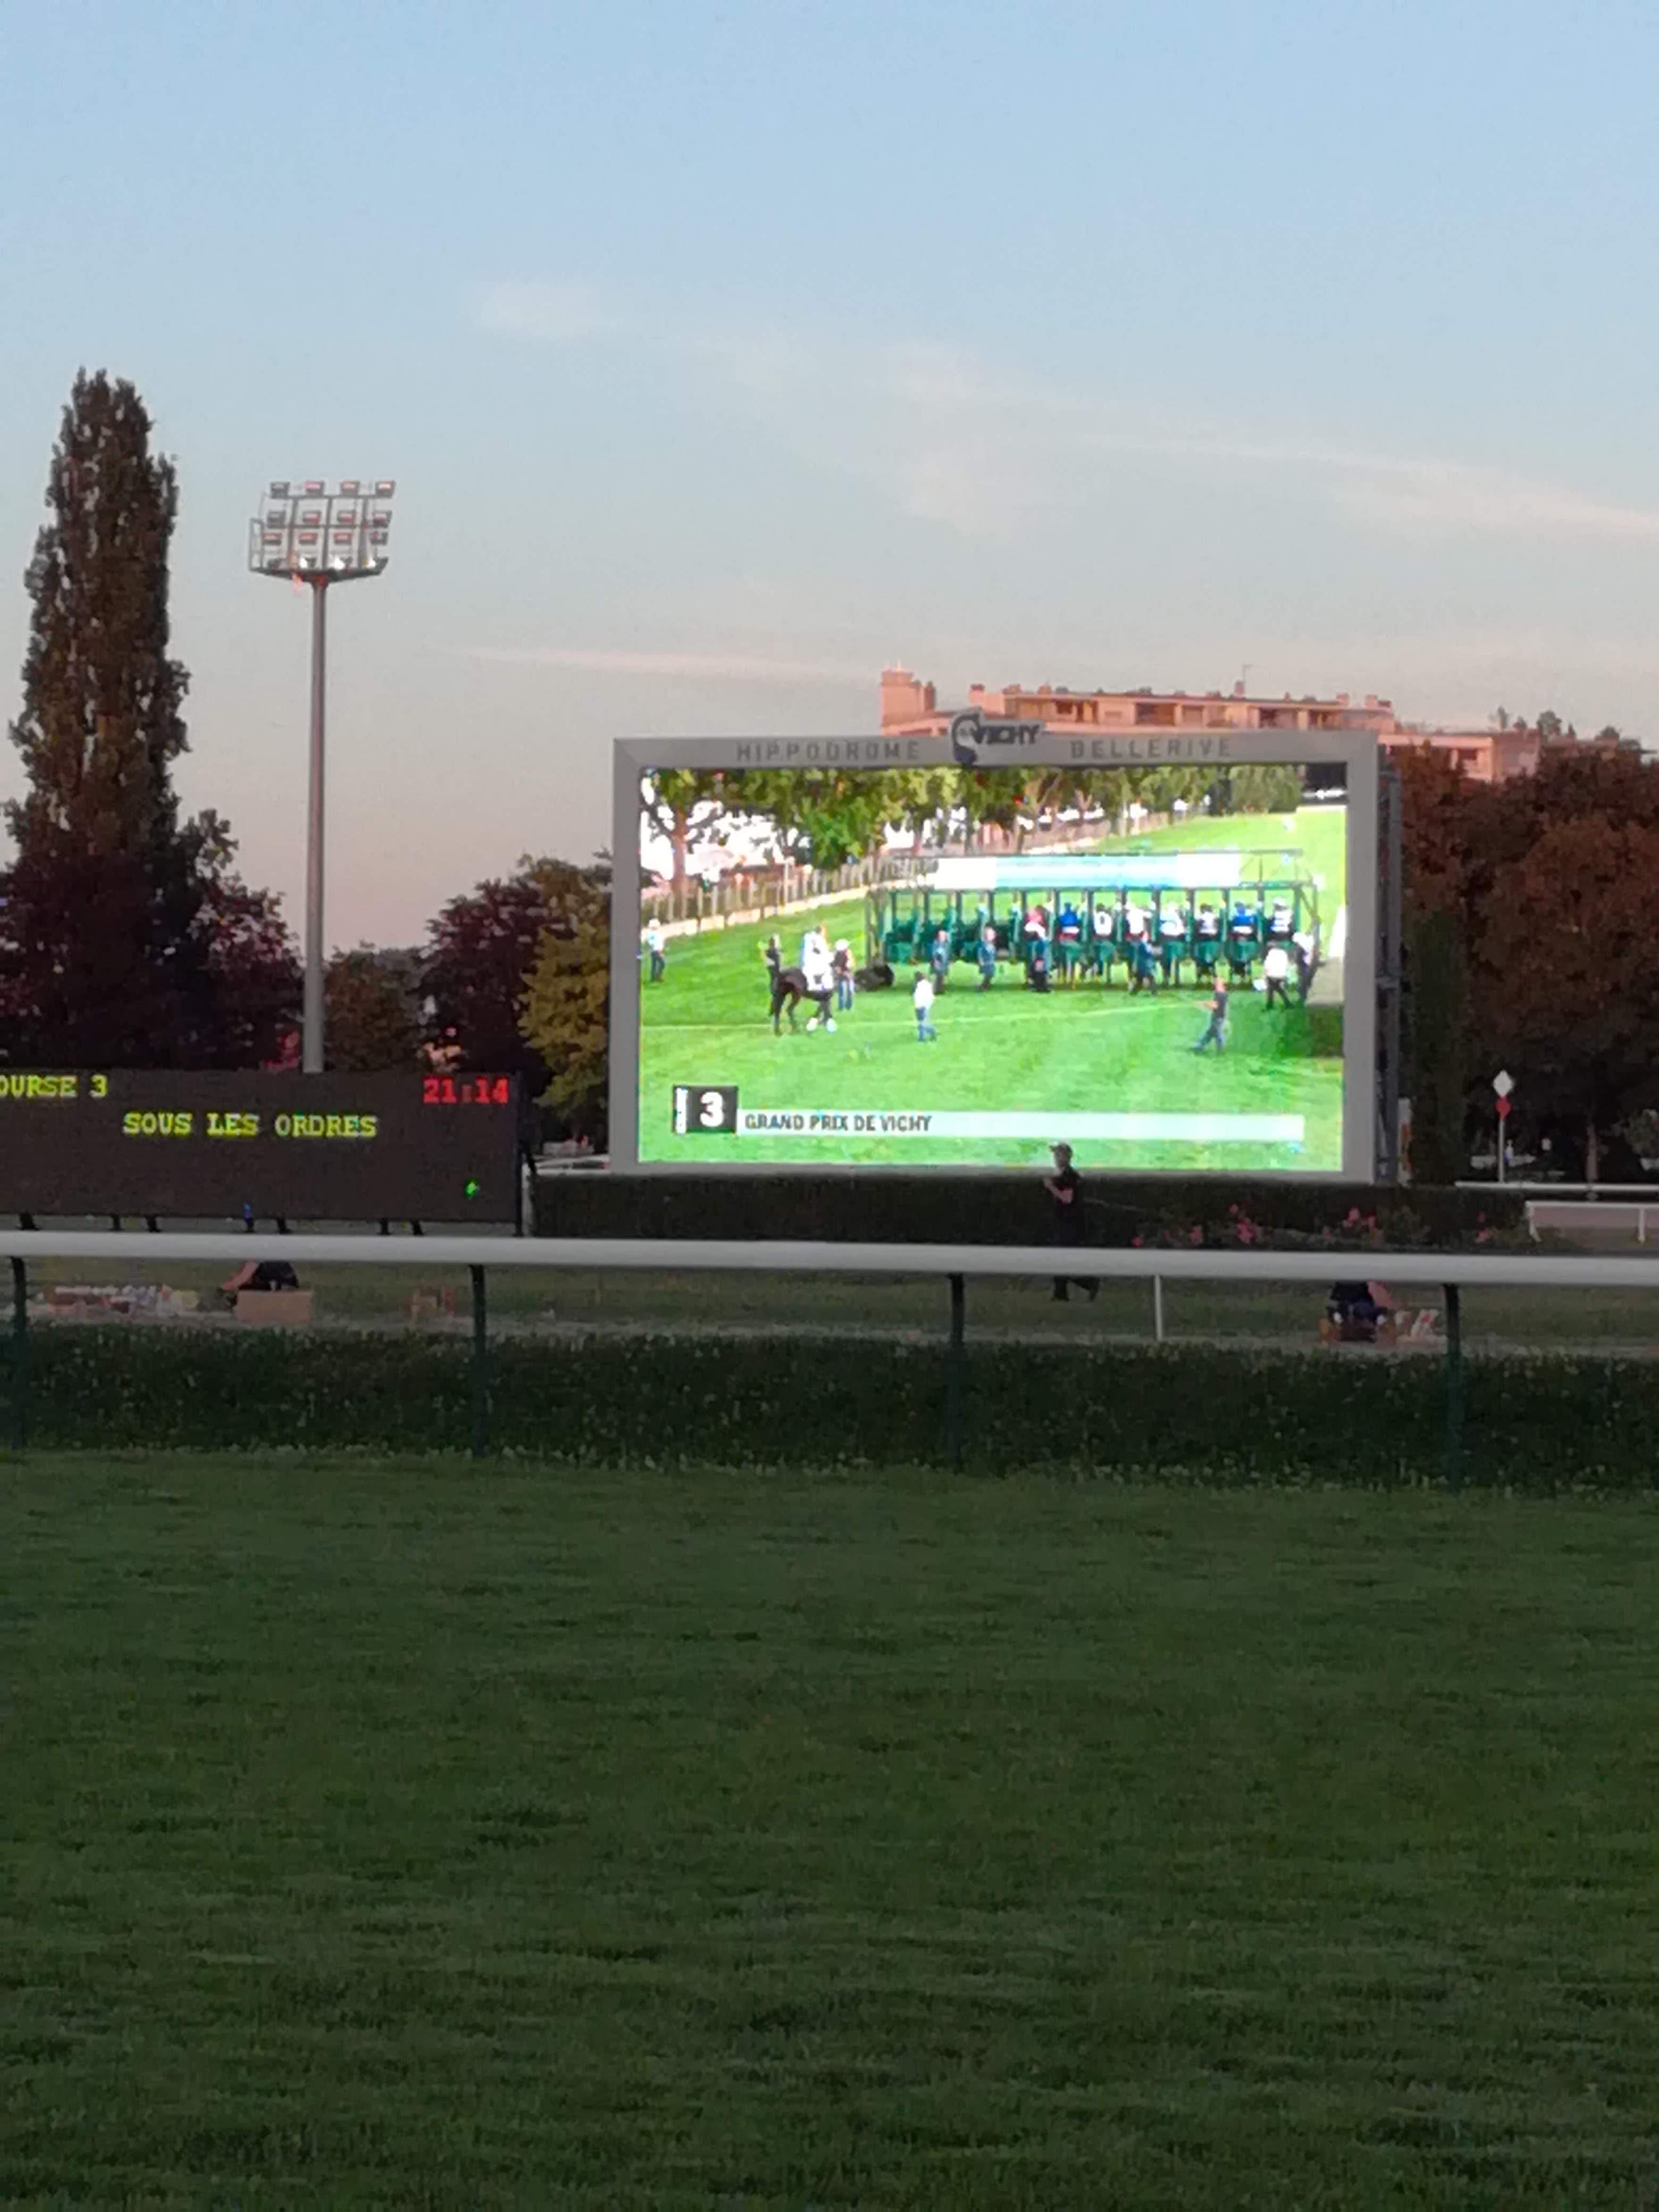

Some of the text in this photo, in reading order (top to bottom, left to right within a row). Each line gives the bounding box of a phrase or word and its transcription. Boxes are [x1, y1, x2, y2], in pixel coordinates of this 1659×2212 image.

[736, 742, 919, 762] HIPPODROME
[1070, 738, 1230, 759] BELLERIVE
[0, 1074, 107, 1098] OURSE 3
[423, 1076, 509, 1104] 21:14
[700, 1091, 725, 1127] 3
[122, 1112, 379, 1138] SOUS LES ORDRES
[745, 1114, 932, 1132] GRAND PRIX DE VICHY
